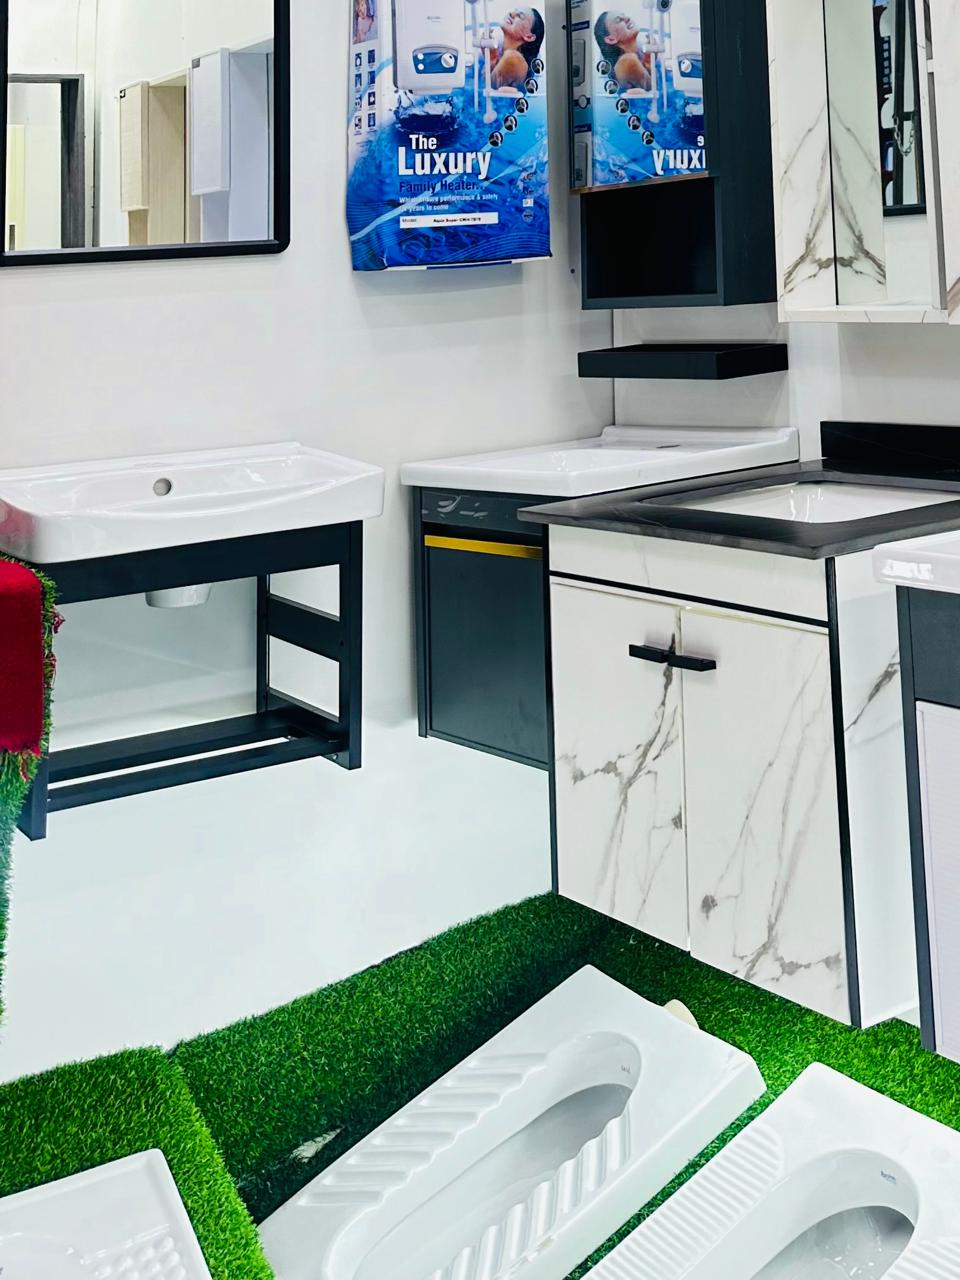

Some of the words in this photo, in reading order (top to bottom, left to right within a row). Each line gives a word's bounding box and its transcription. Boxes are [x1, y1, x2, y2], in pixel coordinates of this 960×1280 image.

[409, 134, 437, 150] The
[398, 146, 492, 180] Luxury
[399, 181, 437, 194] Family
